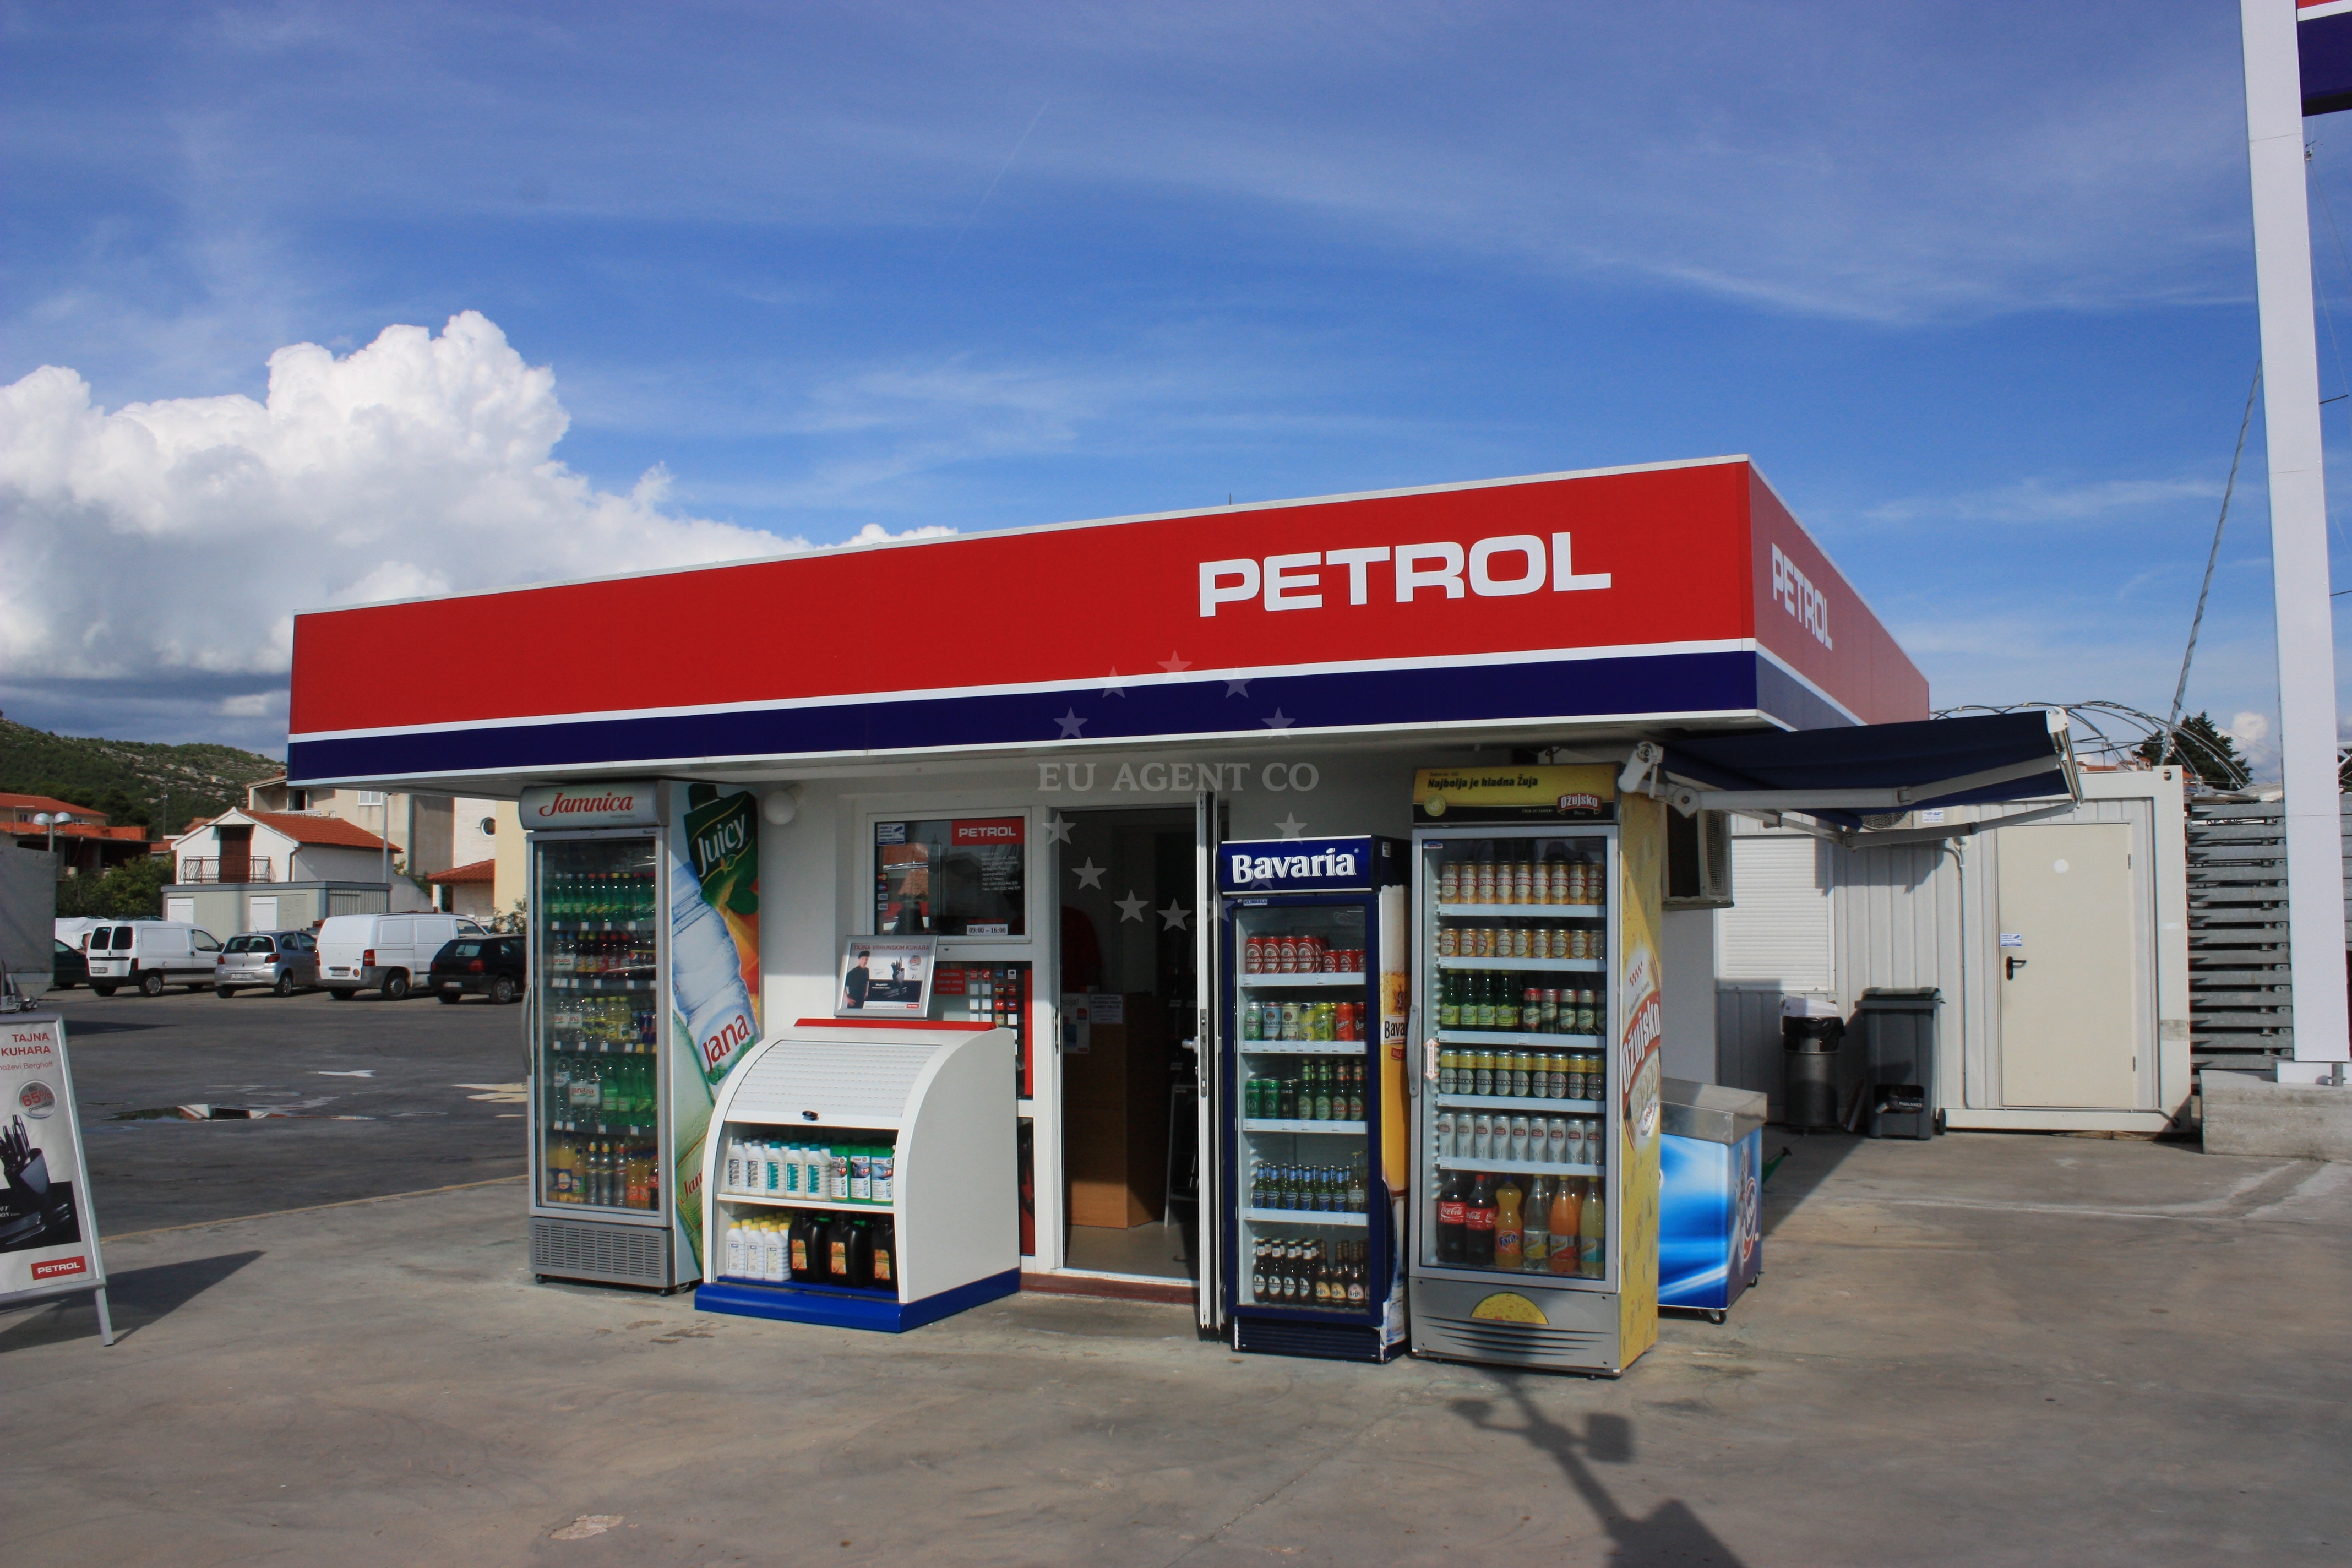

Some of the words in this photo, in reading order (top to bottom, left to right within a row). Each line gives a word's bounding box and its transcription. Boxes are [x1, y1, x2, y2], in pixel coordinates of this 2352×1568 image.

[1199, 531, 1611, 618] PETROL
[1771, 542, 1833, 651] PETROL
[1428, 778, 1467, 790] Najbolja
[1468, 777, 1479, 790] je
[1482, 777, 1515, 787] hladna
[1517, 774, 1538, 788] Žuja
[538, 792, 634, 817] Jamnica
[1561, 794, 1598, 808] Ožujsko
[959, 826, 1016, 837] PETROL
[698, 814, 745, 878] Juicy
[1231, 847, 1357, 883] Bavaria
[1062, 998, 1079, 1008] kcija!
[12, 1032, 50, 1042] TAJNA
[1385, 1020, 1404, 1039] Bava
[1, 1046, 51, 1056] KUHARA
[1622, 1000, 1660, 1094] Ožujsko
[23, 1061, 53, 1070] Berghoff
[21, 1088, 53, 1107] 65%
[29, 1101, 52, 1113] popusta
[37, 1262, 81, 1275] PETROL
